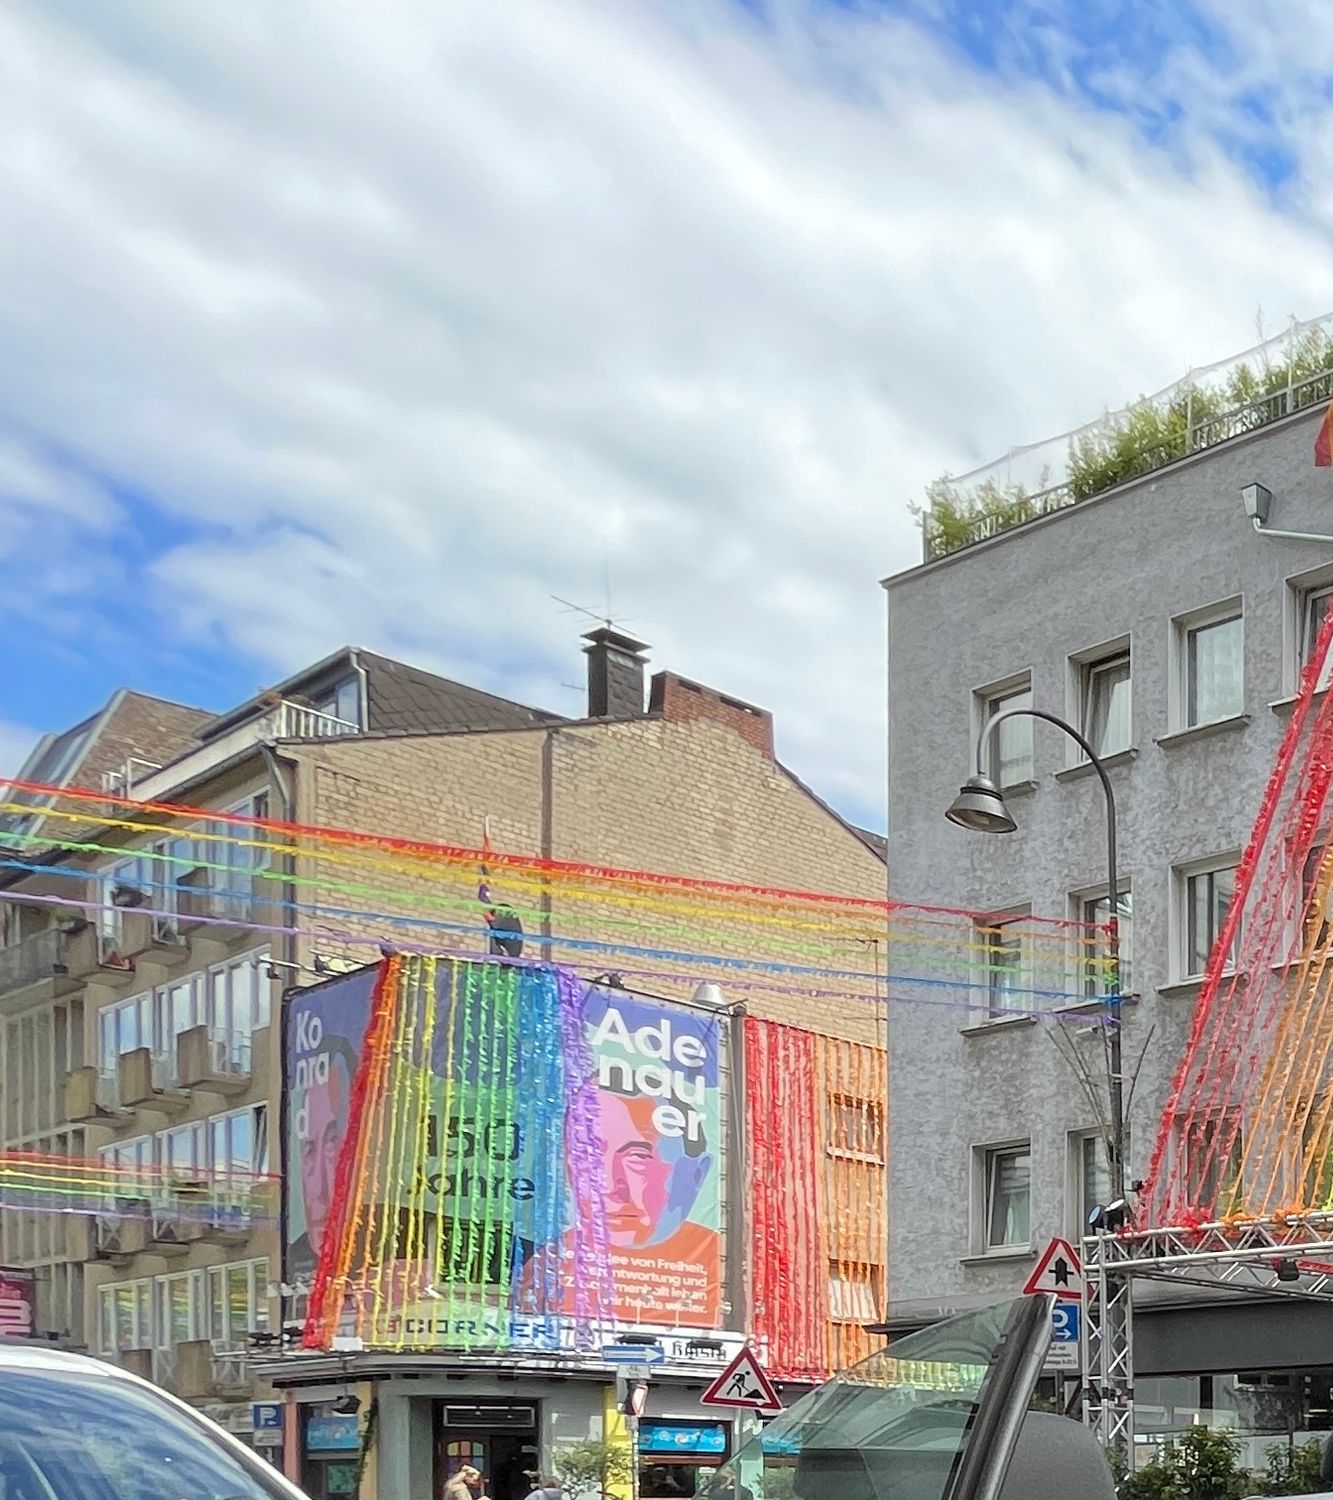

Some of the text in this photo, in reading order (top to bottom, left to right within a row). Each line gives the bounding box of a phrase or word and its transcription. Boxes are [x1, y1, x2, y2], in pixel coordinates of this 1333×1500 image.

[296, 1010, 323, 1053] Ko
[591, 1008, 707, 1068] Ade
[296, 1052, 330, 1089] nra
[598, 1055, 706, 1106] nau
[427, 1115, 521, 1160] 150
[652, 1105, 707, 1141] er
[631, 1258, 656, 1270] von
[657, 1257, 708, 1276] Freiheit,
[260, 1407, 277, 1426] P
